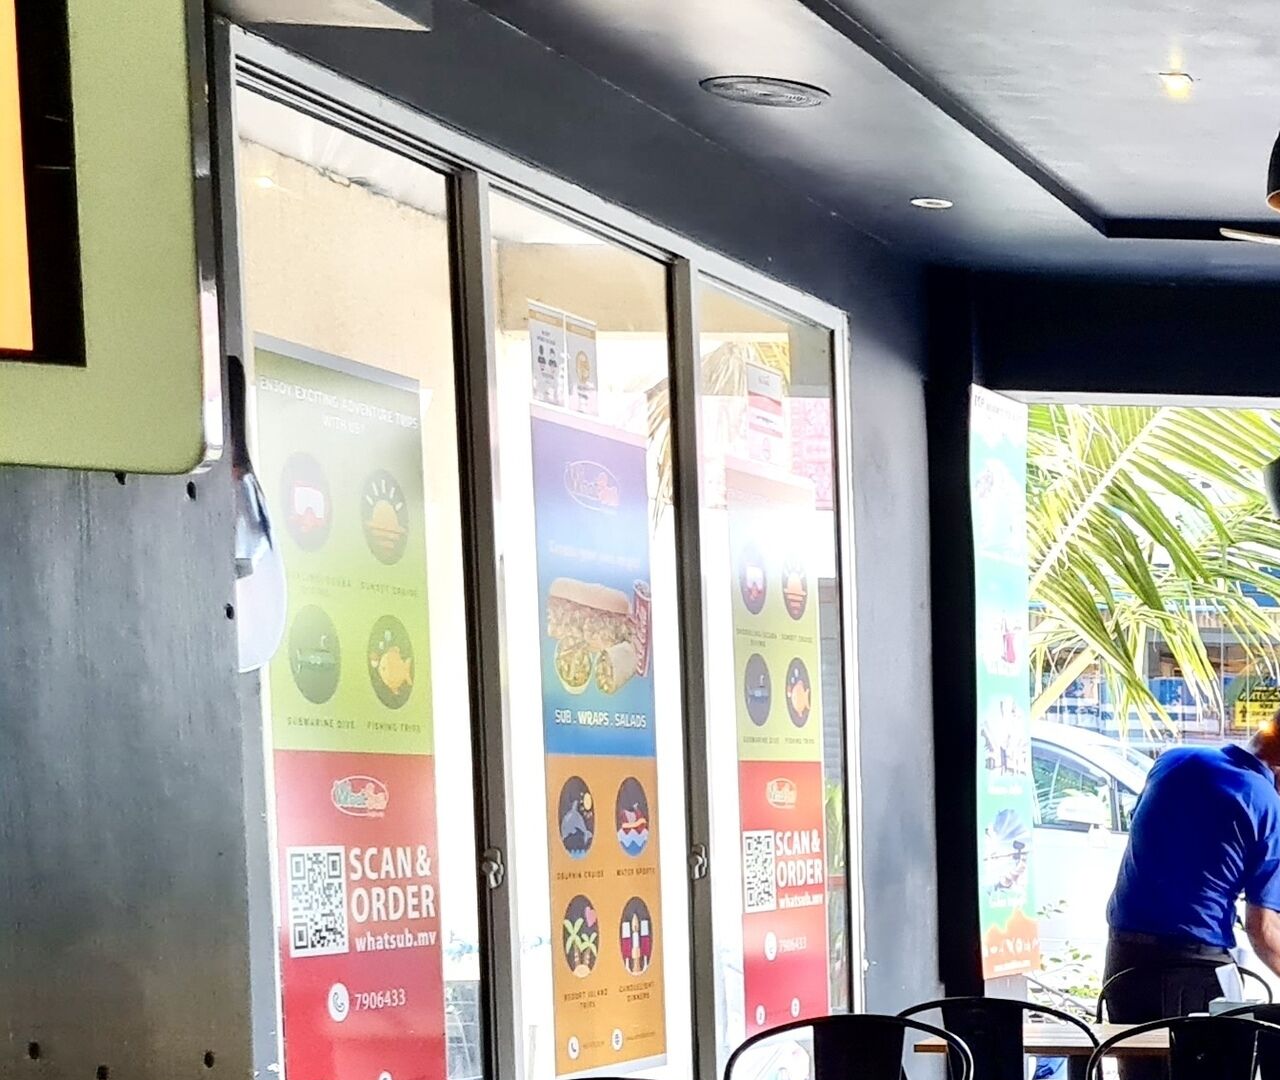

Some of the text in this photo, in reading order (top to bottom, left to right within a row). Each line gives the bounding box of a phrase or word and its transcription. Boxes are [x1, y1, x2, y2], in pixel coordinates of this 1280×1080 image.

[260, 376, 419, 430] ENJOY EXCITING ADVENTURE TRIPS
[614, 713, 647, 728] SALADS
[775, 827, 821, 857] SCAN &
[350, 844, 432, 881] SCAN &
[776, 858, 823, 888] ORDER
[351, 883, 436, 923] ORDER
[354, 927, 438, 952] whatsub.mv
[353, 987, 407, 1011] 7906433
